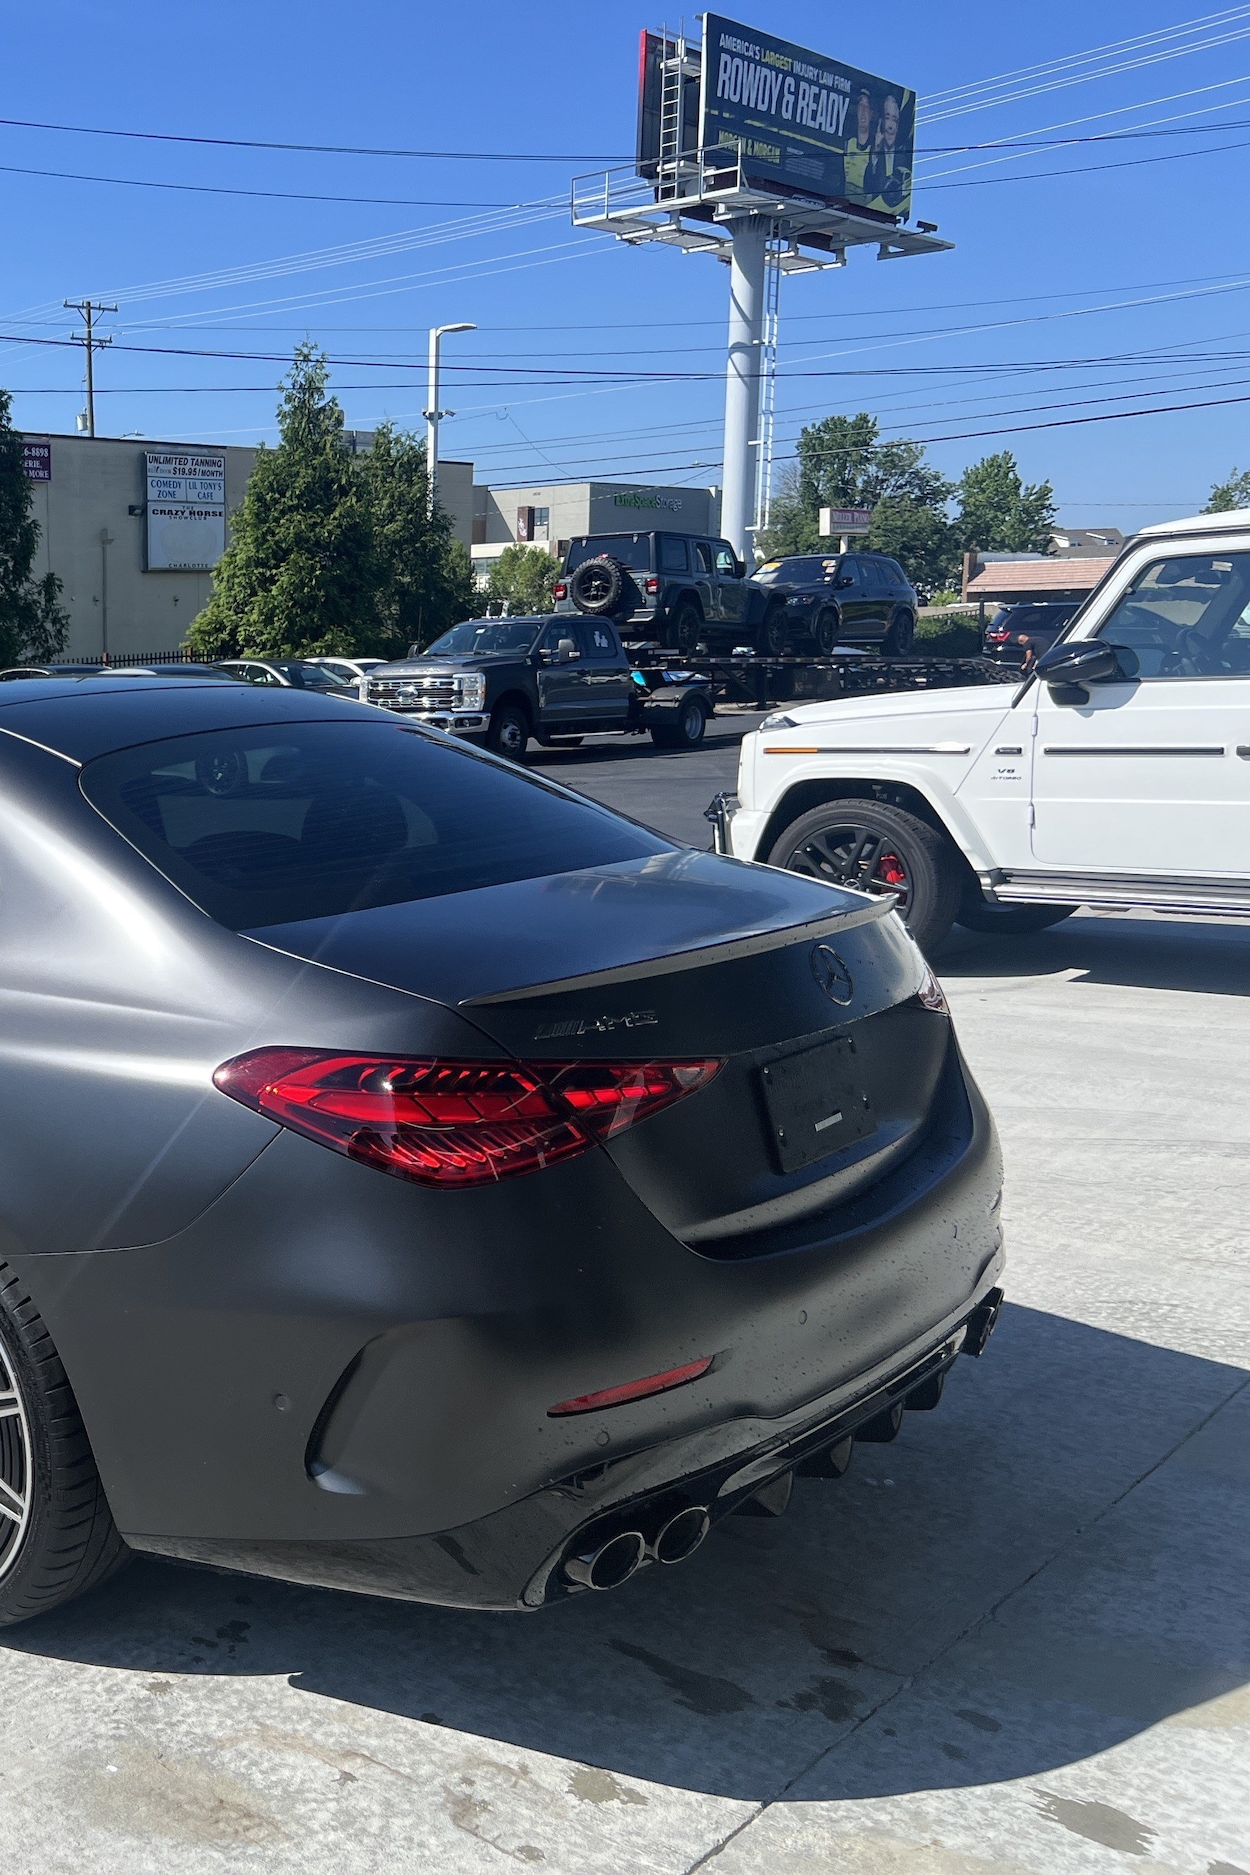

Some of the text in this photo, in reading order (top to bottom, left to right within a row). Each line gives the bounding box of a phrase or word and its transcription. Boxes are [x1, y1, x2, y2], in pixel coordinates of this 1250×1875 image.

[719, 33, 851, 93] AMERICA'S LARGEST INJURY LAW FIRM
[717, 53, 850, 137] ROWDY & READY
[21, 447, 49, 458] 6-8898
[148, 455, 223, 468] UNLIMITED TANNING
[29, 470, 50, 478] MORE
[151, 479, 182, 489] COMEDY
[188, 481, 222, 491] LIL TONY'S
[157, 490, 177, 499] ZONE
[197, 492, 214, 500] CAFE
[189, 510, 224, 518] HORSE
